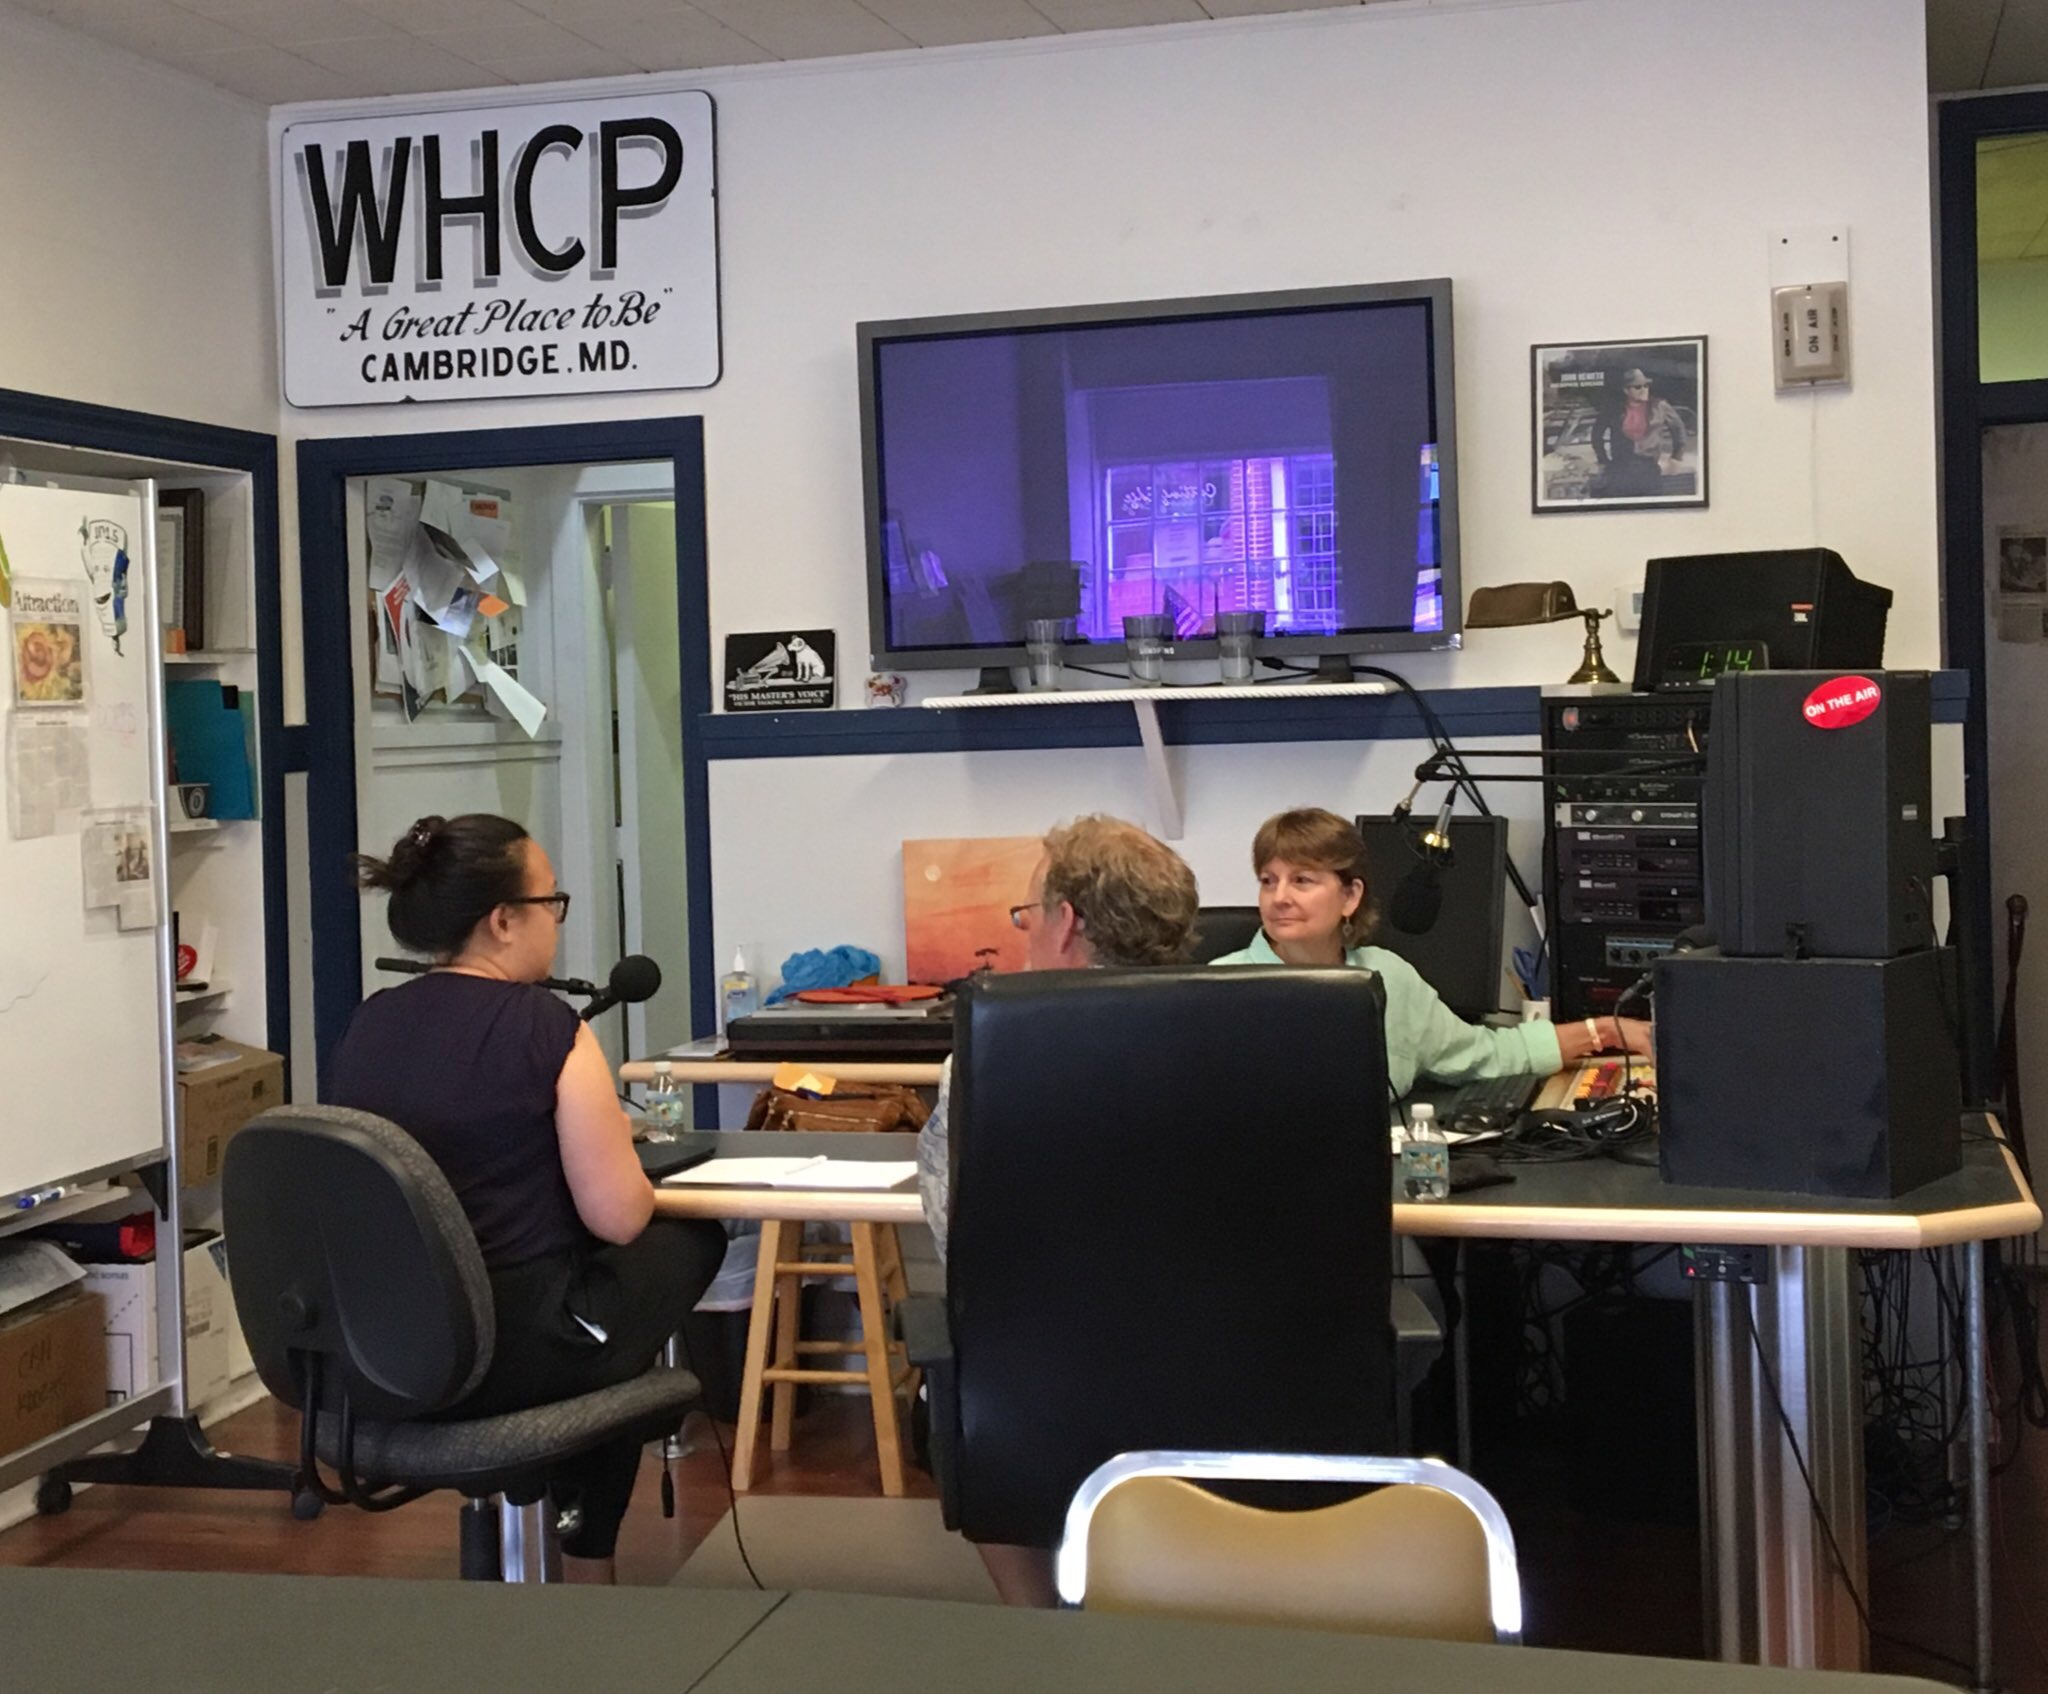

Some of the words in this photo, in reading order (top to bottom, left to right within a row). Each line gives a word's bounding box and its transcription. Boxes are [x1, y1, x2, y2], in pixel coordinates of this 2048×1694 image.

[298, 117, 684, 293] WHCP
[382, 301, 479, 340] Great
[474, 297, 576, 335] Place
[581, 293, 609, 331] to
[1806, 308, 1819, 329] AIR
[1808, 335, 1820, 354] ON
[1805, 703, 1826, 718] ON
[1826, 694, 1854, 712] THE
[1855, 686, 1879, 702] AIR
